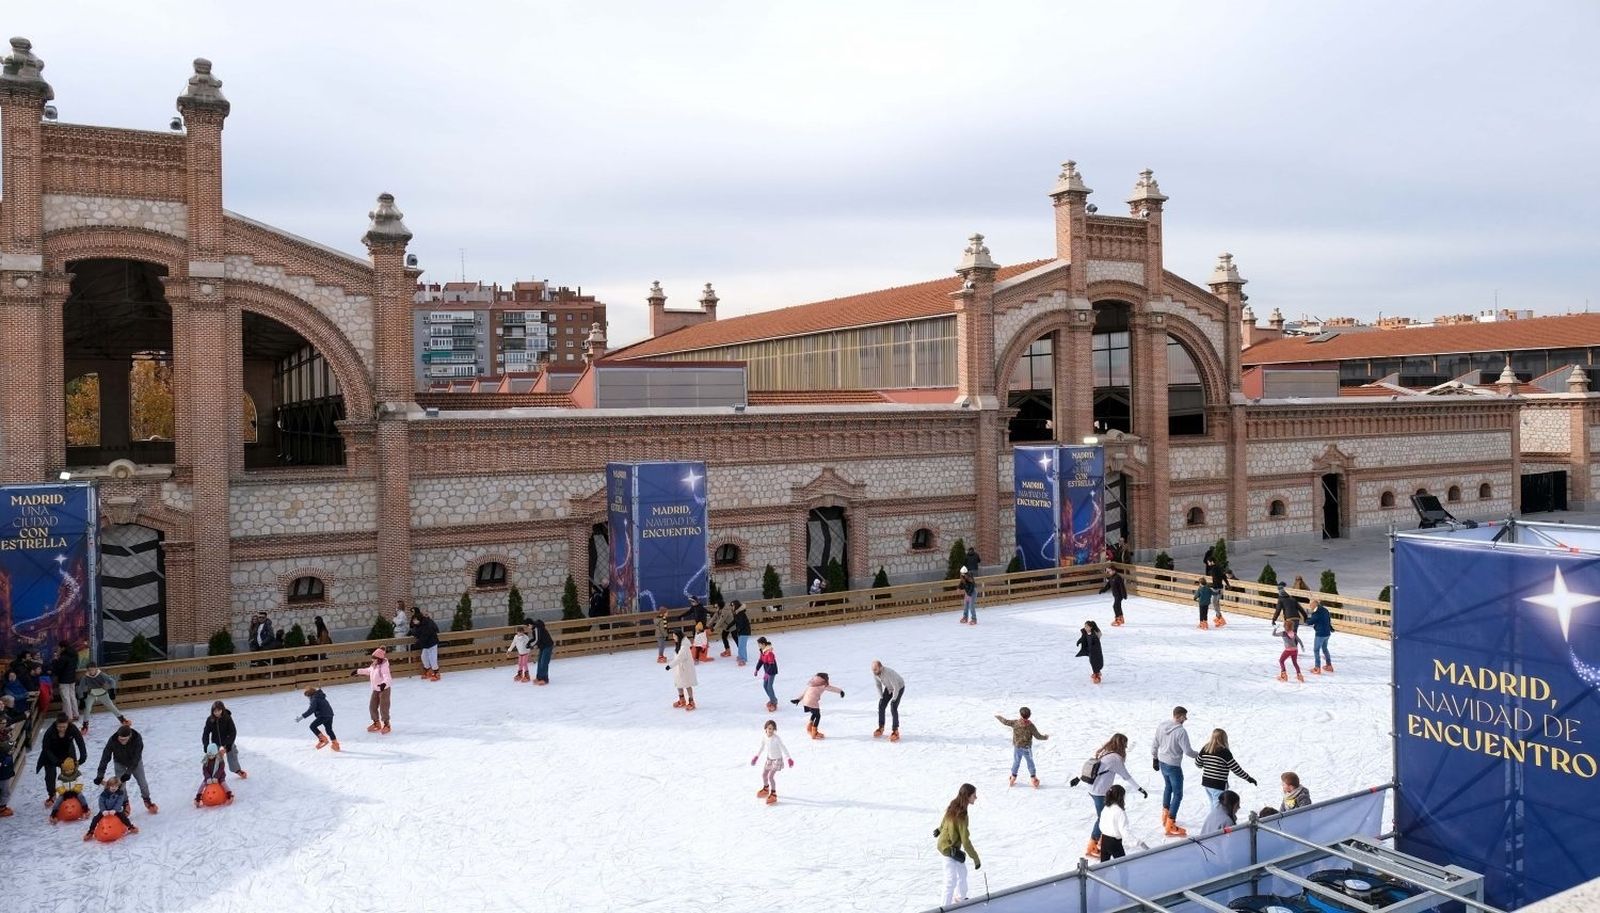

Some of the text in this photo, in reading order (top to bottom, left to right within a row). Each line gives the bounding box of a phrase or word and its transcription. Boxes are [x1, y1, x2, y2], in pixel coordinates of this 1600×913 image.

[11, 494, 66, 506] MADRID,
[21, 506, 50, 516] UNA
[652, 505, 691, 515] MADRID,
[12, 515, 59, 528] CIUDAD
[645, 515, 698, 527] NAVIDAD DE
[19, 527, 49, 539] CON
[642, 527, 702, 539] ENCUENTRO
[1, 537, 67, 550] ESTRELLA
[1433, 658, 1558, 710] MADRID,
[1416, 687, 1583, 744] NAVIDAD DE
[1408, 714, 1597, 778] ENCUENTRO
